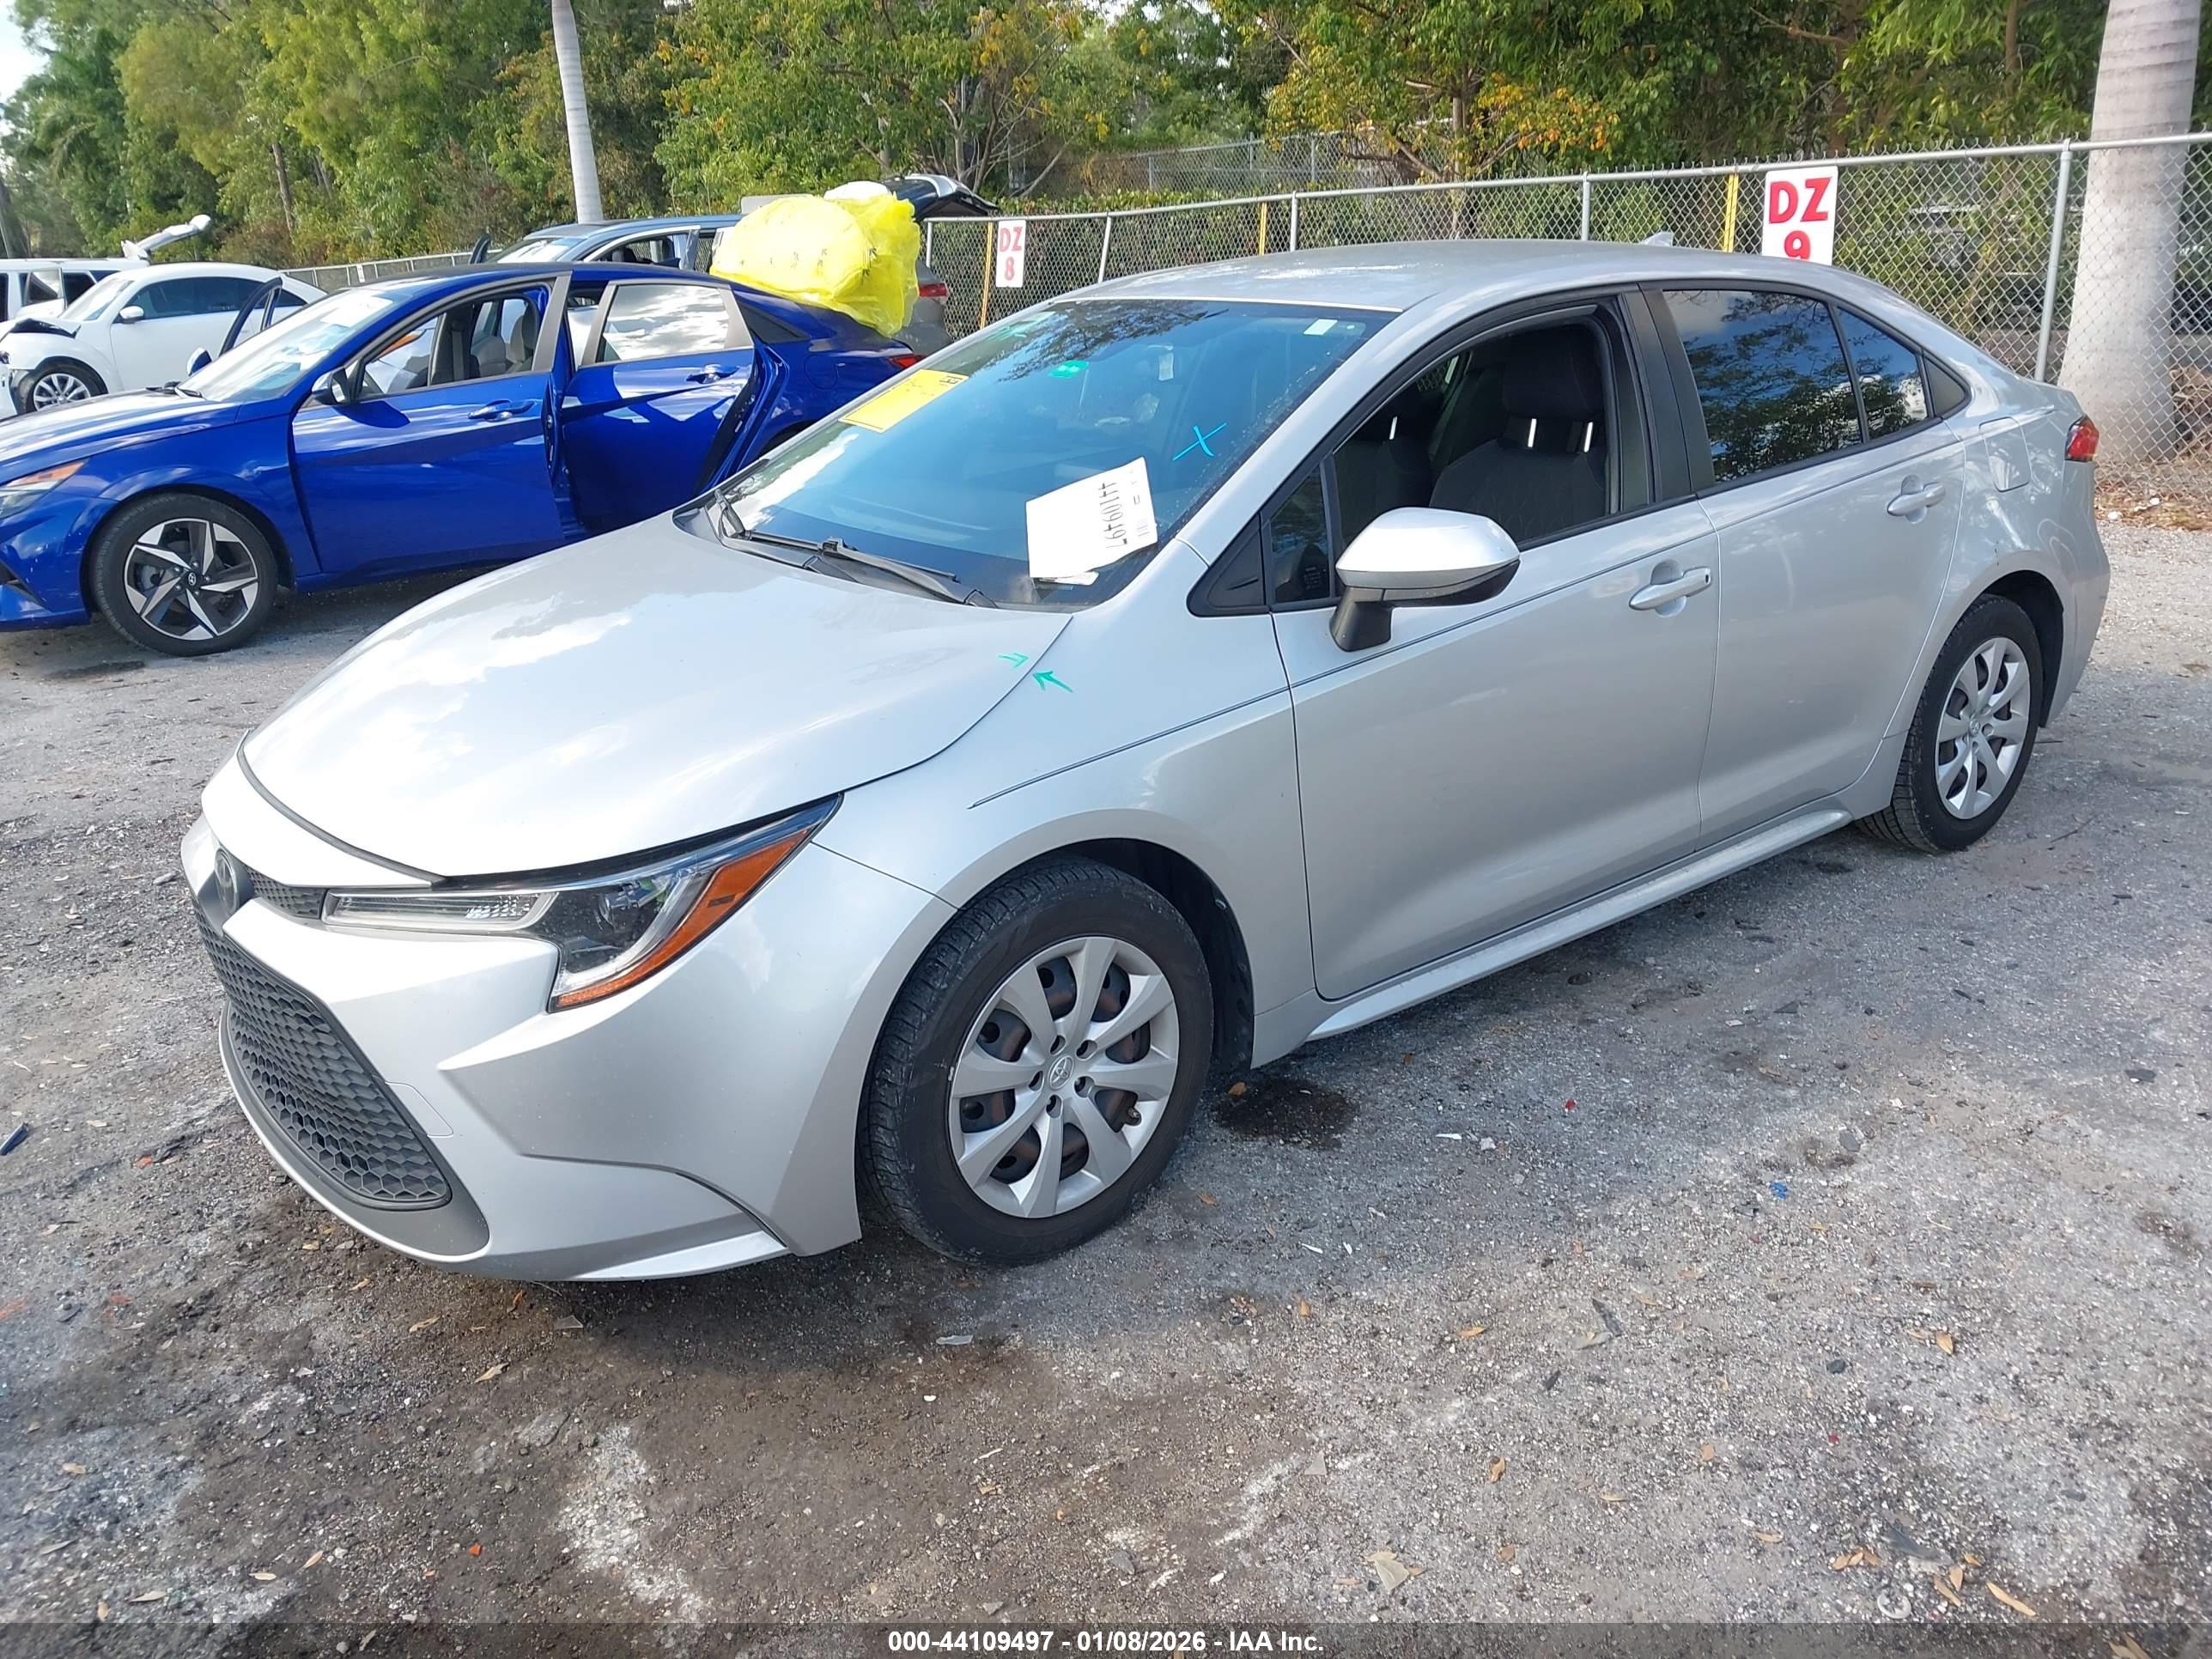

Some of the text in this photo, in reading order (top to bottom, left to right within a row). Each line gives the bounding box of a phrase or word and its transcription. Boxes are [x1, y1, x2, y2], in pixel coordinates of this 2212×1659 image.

[1769, 177, 1832, 224] DZ
[999, 226, 1023, 252] DZ
[1784, 230, 1811, 261] 9
[1004, 256, 1015, 281] 8
[1098, 482, 1127, 548] 44109497
